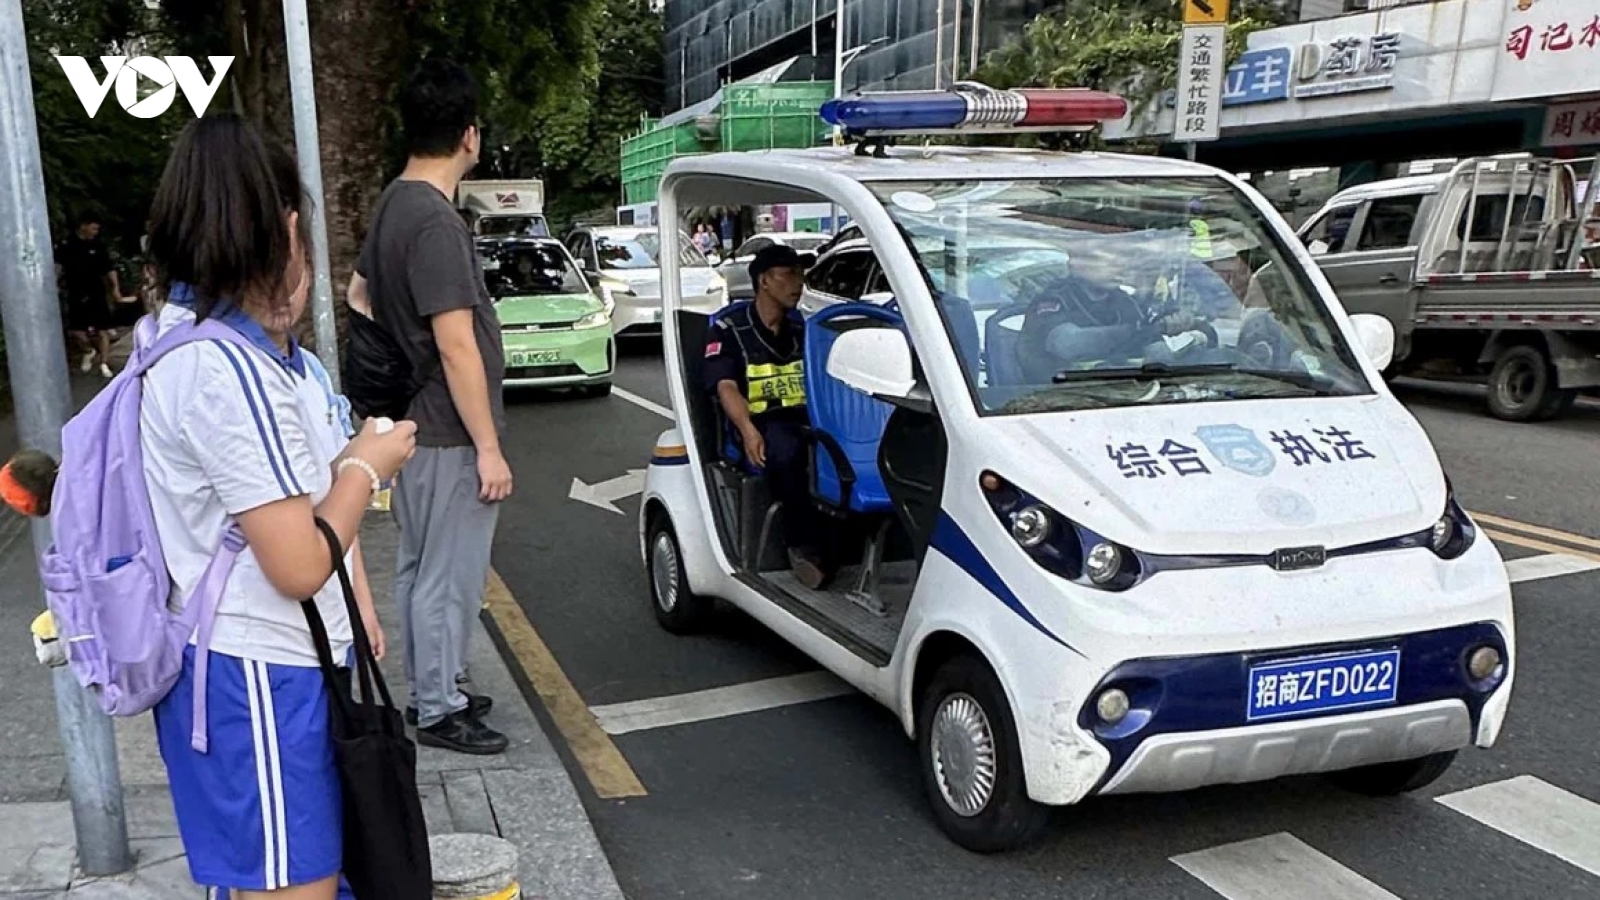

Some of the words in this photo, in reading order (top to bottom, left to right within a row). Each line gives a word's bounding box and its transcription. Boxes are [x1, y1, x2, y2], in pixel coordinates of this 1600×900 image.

[1185, 33, 1213, 132] 交通繁忙路段
[1105, 438, 1212, 478] 综合
[1268, 425, 1377, 466] 执法
[1255, 660, 1393, 708] 招商ZFD022
